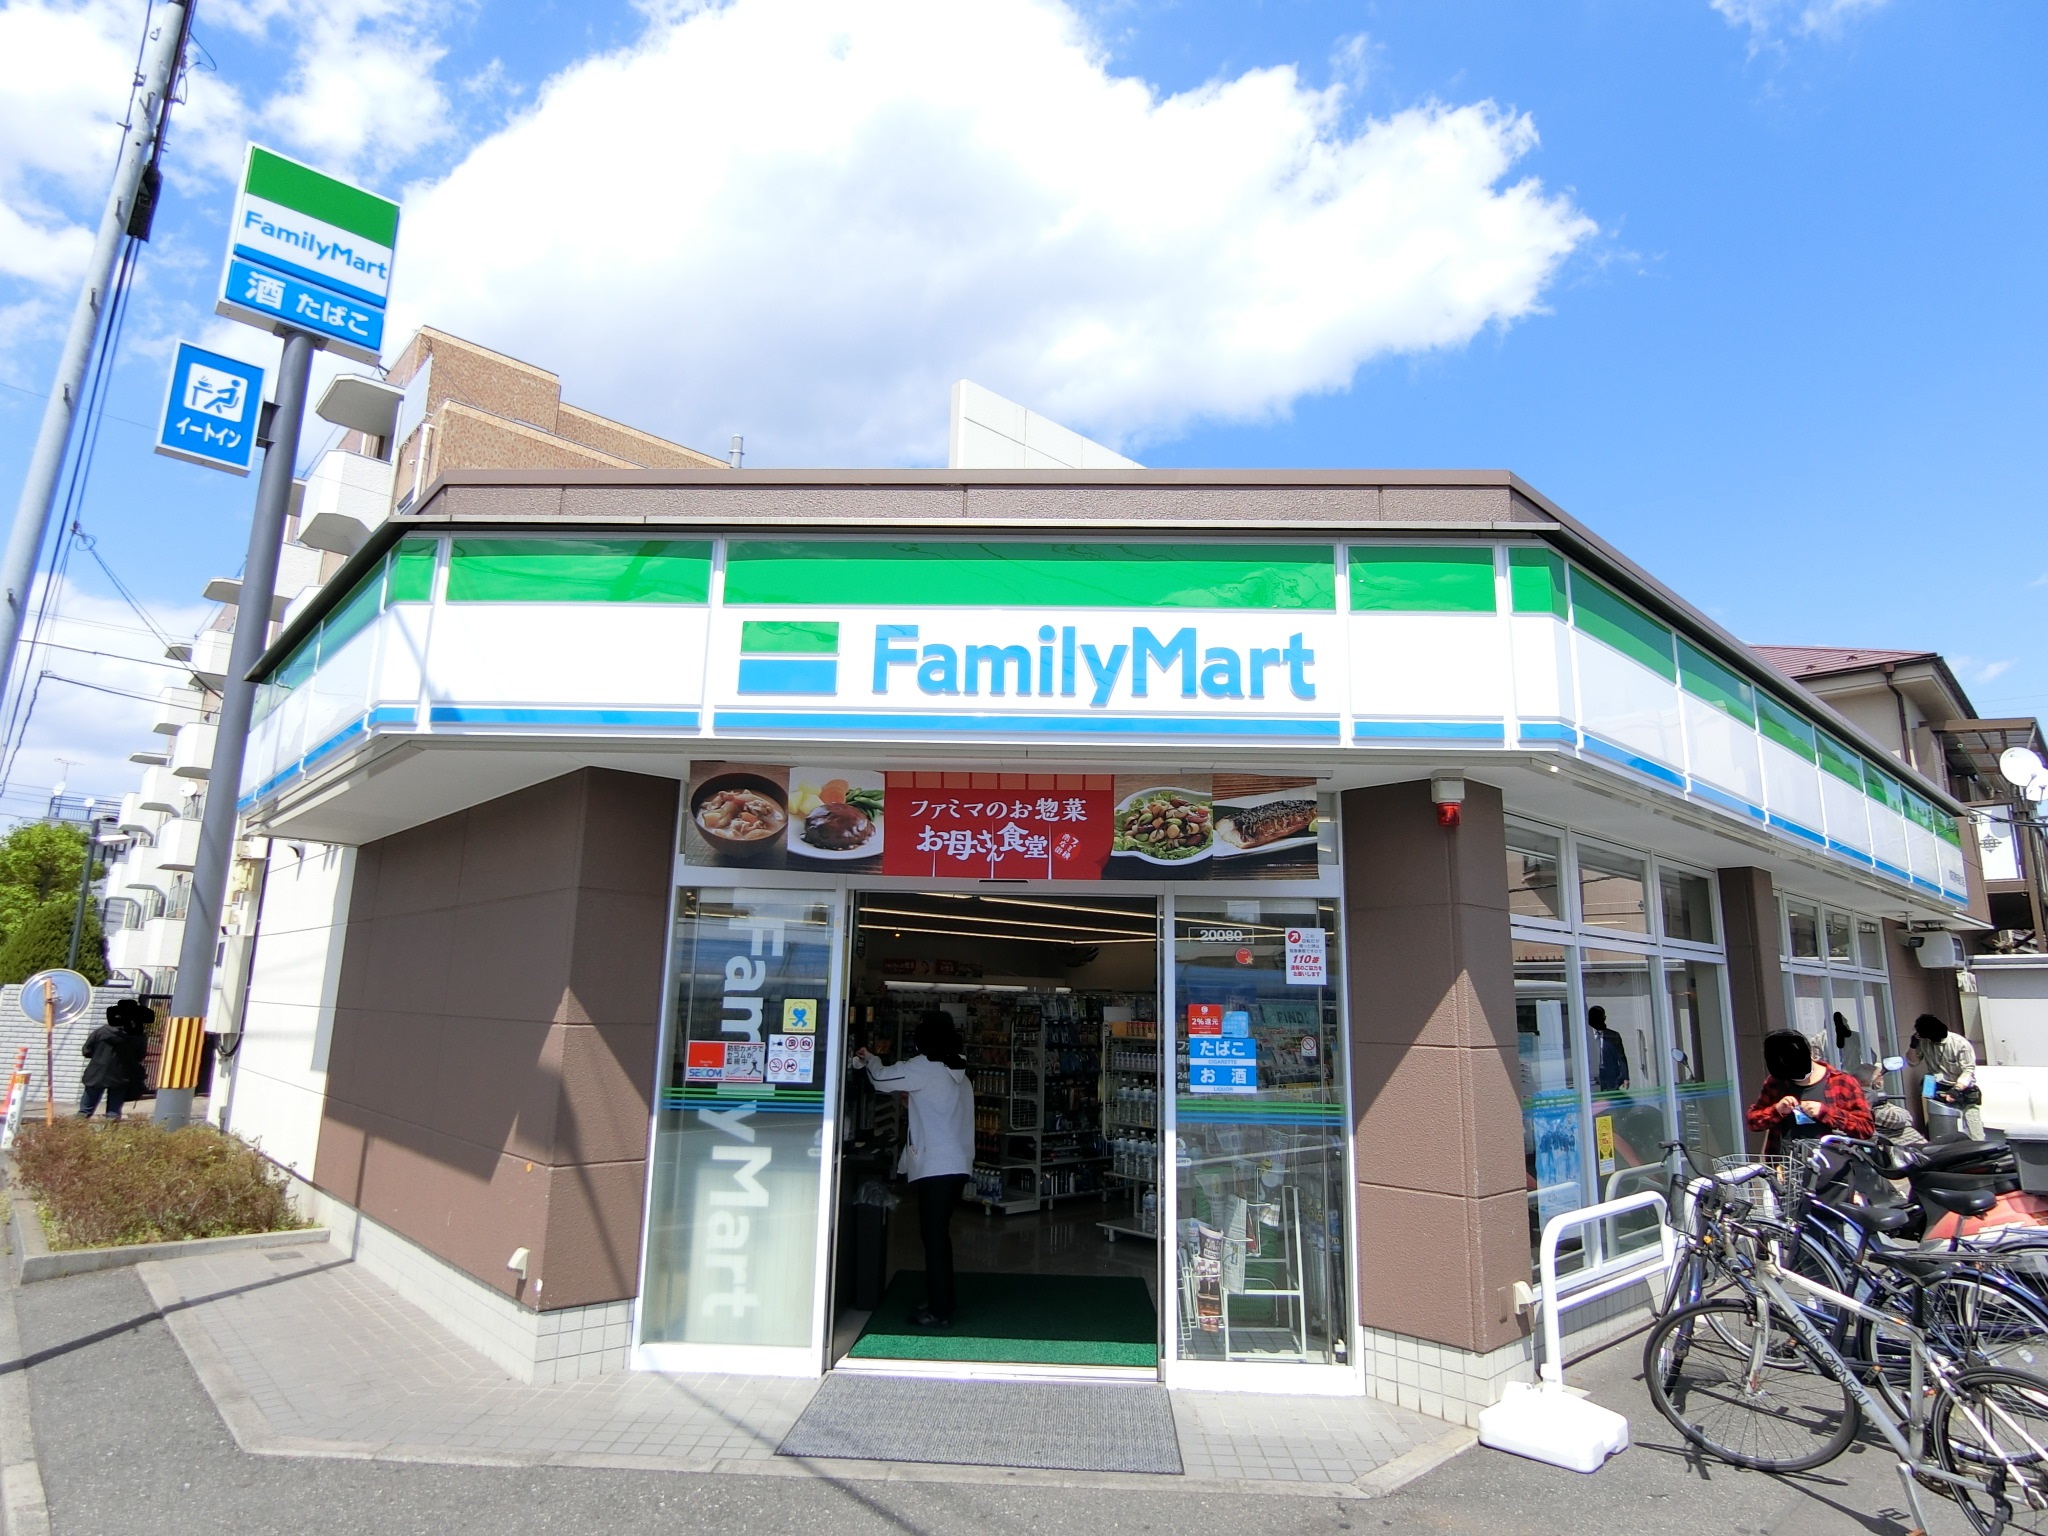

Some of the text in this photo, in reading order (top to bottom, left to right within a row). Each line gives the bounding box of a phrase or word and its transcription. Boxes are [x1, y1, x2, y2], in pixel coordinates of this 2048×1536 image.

[244, 209, 388, 281] FamilyMart
[245, 271, 370, 338] 酒 たばこ
[175, 416, 243, 449] イートイン
[872, 624, 1317, 707] FamilyMart
[910, 797, 1089, 823] ファミマのお惣菜
[915, 820, 1049, 863] お母さん食堂
[1293, 954, 1321, 964] 110番
[726, 1045, 764, 1053] 防犯カメラで
[1199, 1040, 1246, 1057] たばこ
[688, 1068, 722, 1078] SECOM
[1792, 1313, 1824, 1353] LOUIS
